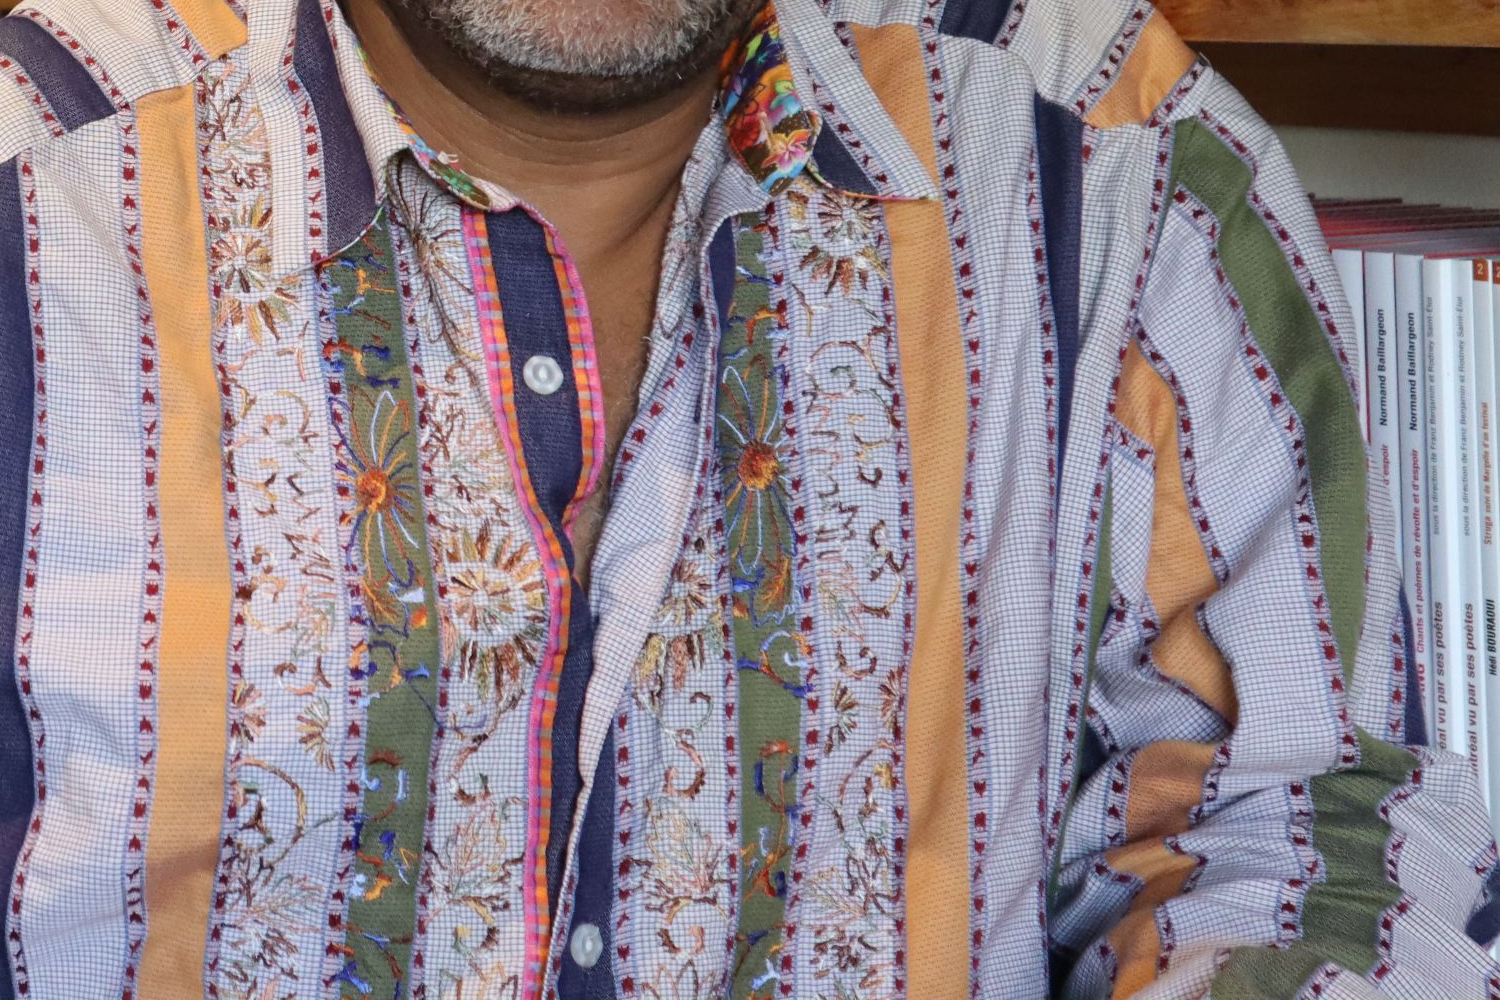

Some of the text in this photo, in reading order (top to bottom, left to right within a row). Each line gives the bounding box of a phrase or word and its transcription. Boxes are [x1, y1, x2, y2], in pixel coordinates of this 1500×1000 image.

[1477, 264, 1484, 274] 2
[1376, 309, 1388, 426] Normand Baillargeon
[1407, 313, 1418, 431] Normand Baillargeon
[1458, 375, 1464, 383] et
[1430, 452, 1437, 462] de
[1461, 453, 1467, 463] de
[1412, 449, 1420, 491] d'espoir
[1430, 465, 1438, 502] direction
[1412, 494, 1420, 504] et
[1432, 515, 1440, 535] sous
[1484, 516, 1493, 544] Struga
[1414, 546, 1421, 557] de
[1415, 561, 1424, 601] poèmes
[1416, 605, 1423, 614] et
[1416, 618, 1424, 653] Chants
[1434, 602, 1445, 648] poètes
[1464, 603, 1476, 650] poètes
[1486, 599, 1497, 675] Hédi BOURAOUI
[1436, 653, 1444, 676] ses
[1466, 654, 1475, 678] ses
[1436, 680, 1447, 703] par
[1467, 682, 1477, 706] par
[1438, 708, 1446, 723] vu
[1468, 709, 1476, 726] vu
